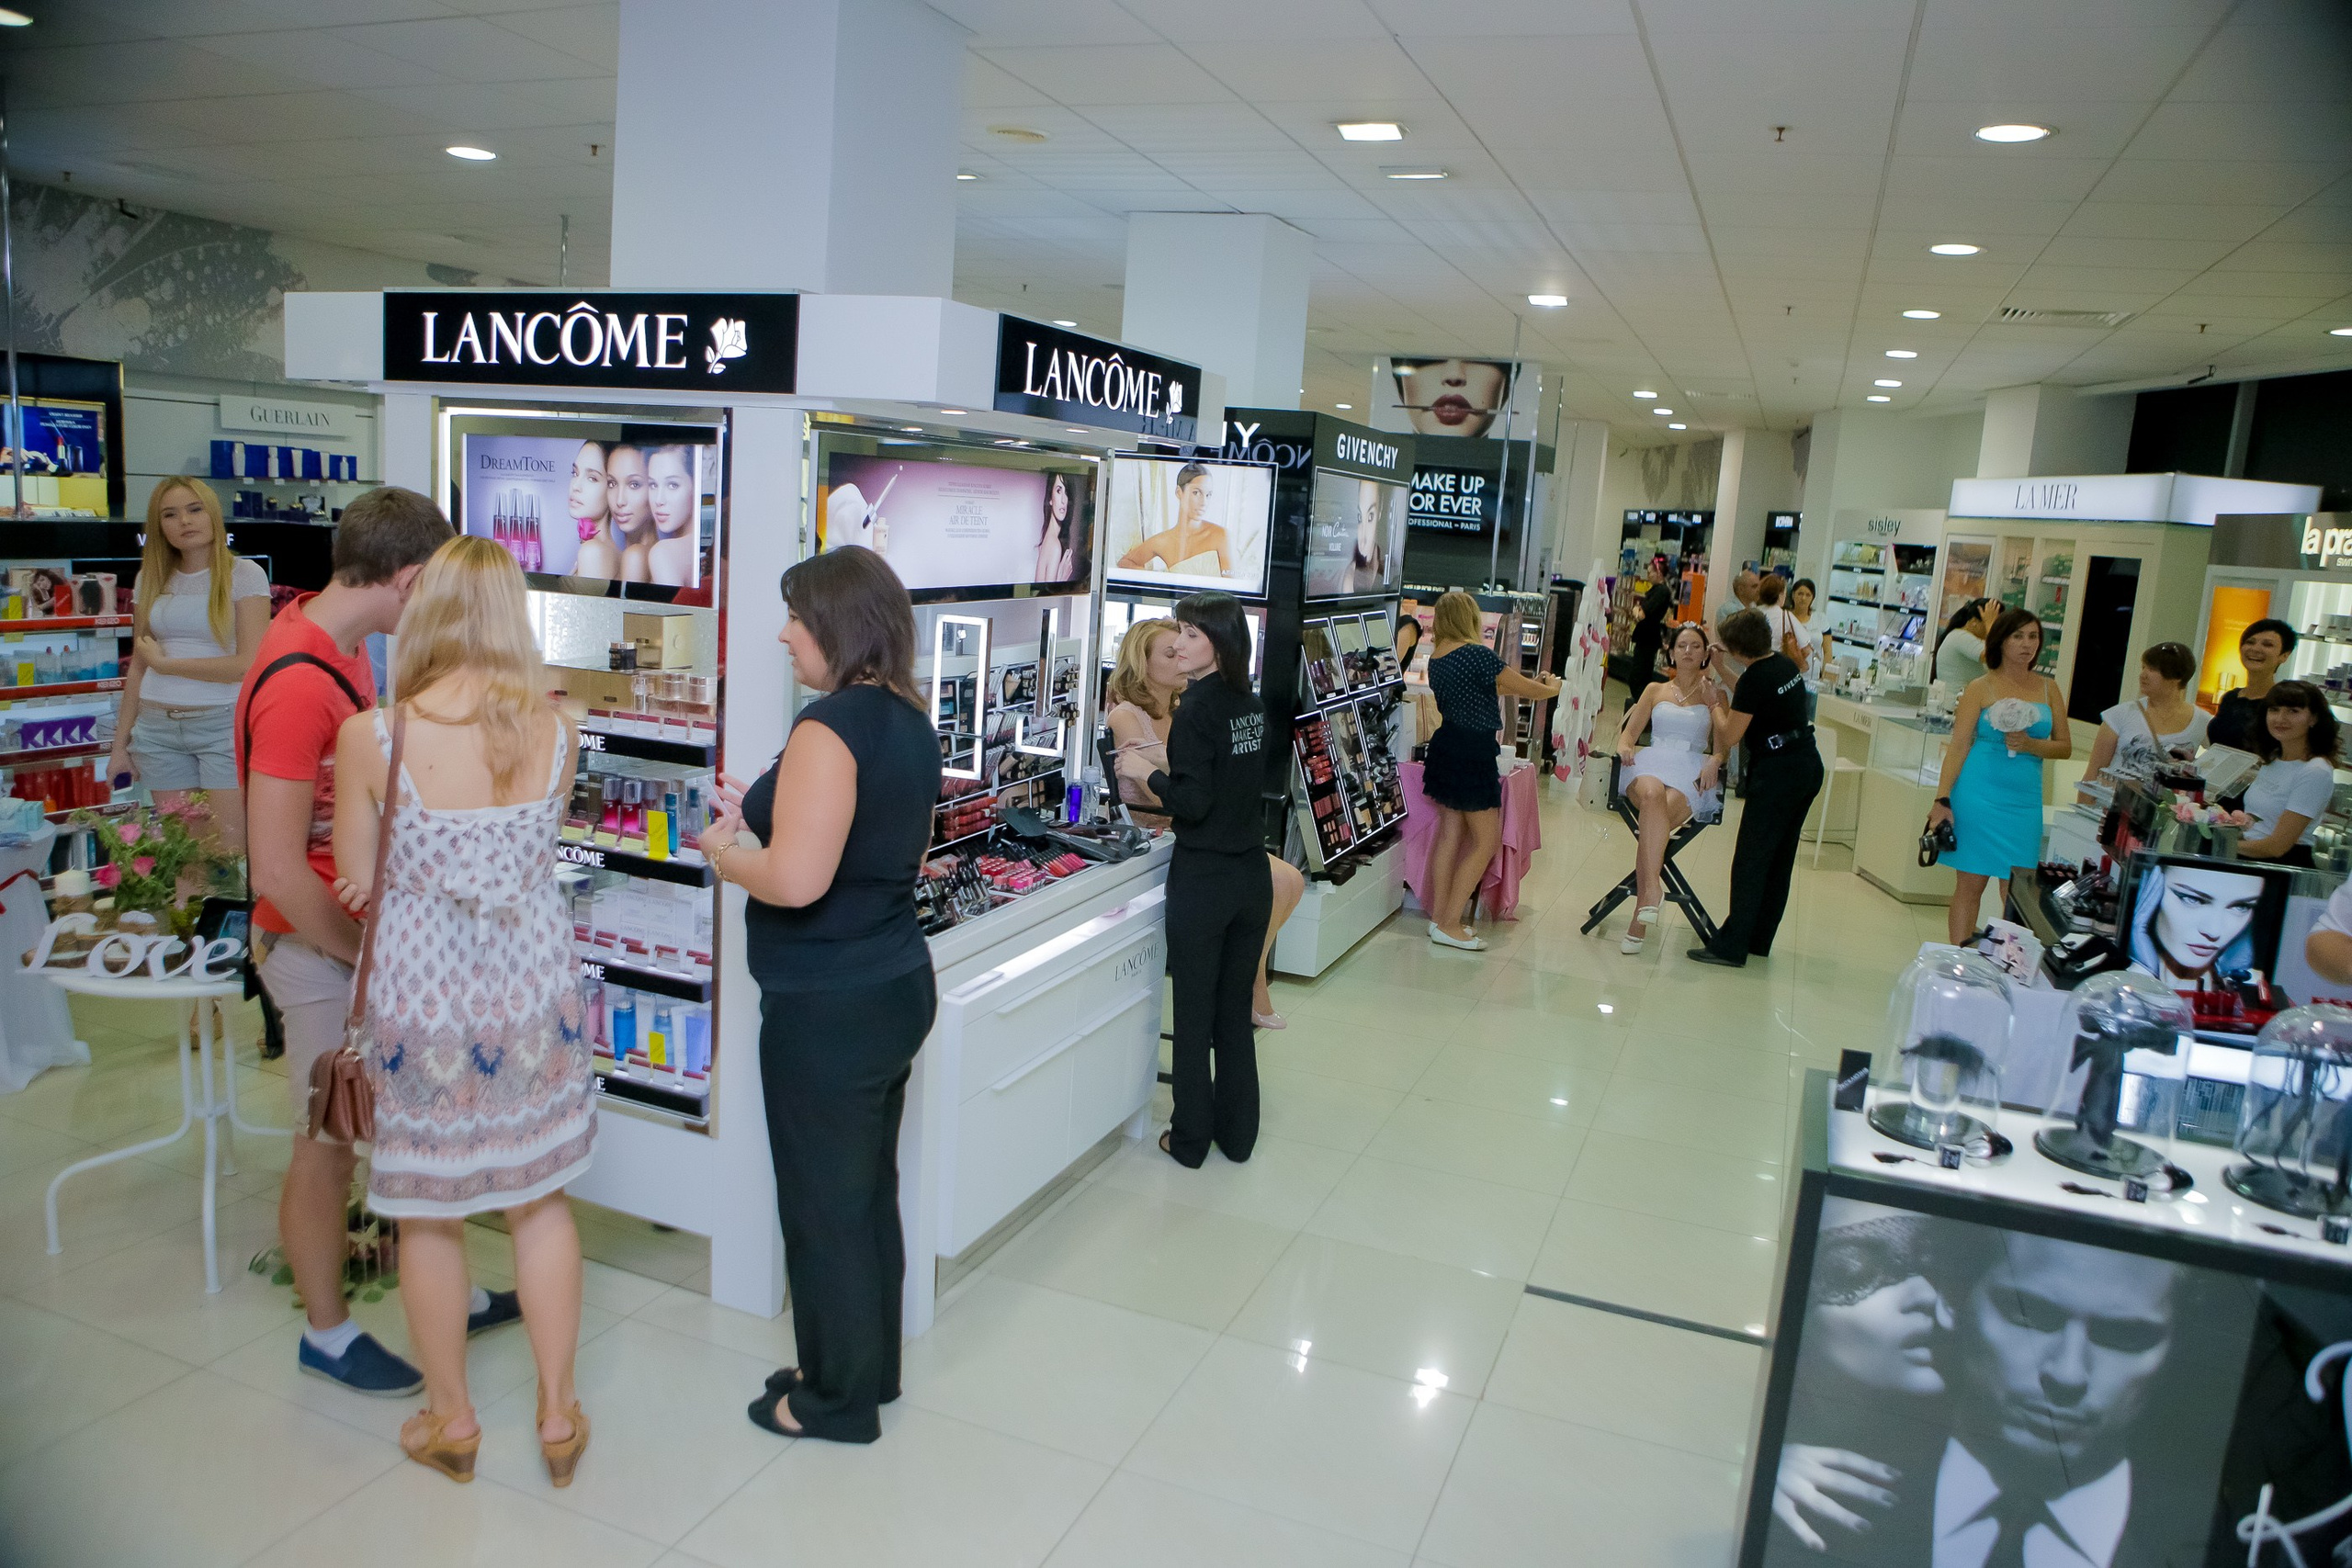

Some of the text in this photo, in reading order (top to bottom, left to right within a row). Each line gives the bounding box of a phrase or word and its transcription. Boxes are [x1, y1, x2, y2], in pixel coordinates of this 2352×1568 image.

[421, 301, 688, 369] LANCÔME
[1023, 341, 1162, 419] LANCÔME
[250, 406, 331, 427] GUERLAIN
[1337, 433, 1399, 469] GIVENCHY
[1461, 475, 1486, 494] UP
[1409, 492, 1482, 515] OR EVER
[2015, 484, 2077, 510] LA MER
[956, 505, 983, 515] MIRACLE
[1408, 518, 1453, 529] OFESSIONAL
[1460, 522, 1481, 531] PARIS
[1868, 515, 1901, 537] sisley
[2301, 516, 2322, 555] la
[1778, 673, 1802, 694] GIVENC
[1230, 713, 1264, 731] LANCÔME
[1232, 726, 1264, 743] MAKE-UP
[1231, 739, 1261, 755] ARTIST
[557, 845, 605, 868] NCÔME
[18, 911, 242, 983] Love
[1114, 941, 1159, 981] LANCÔME
